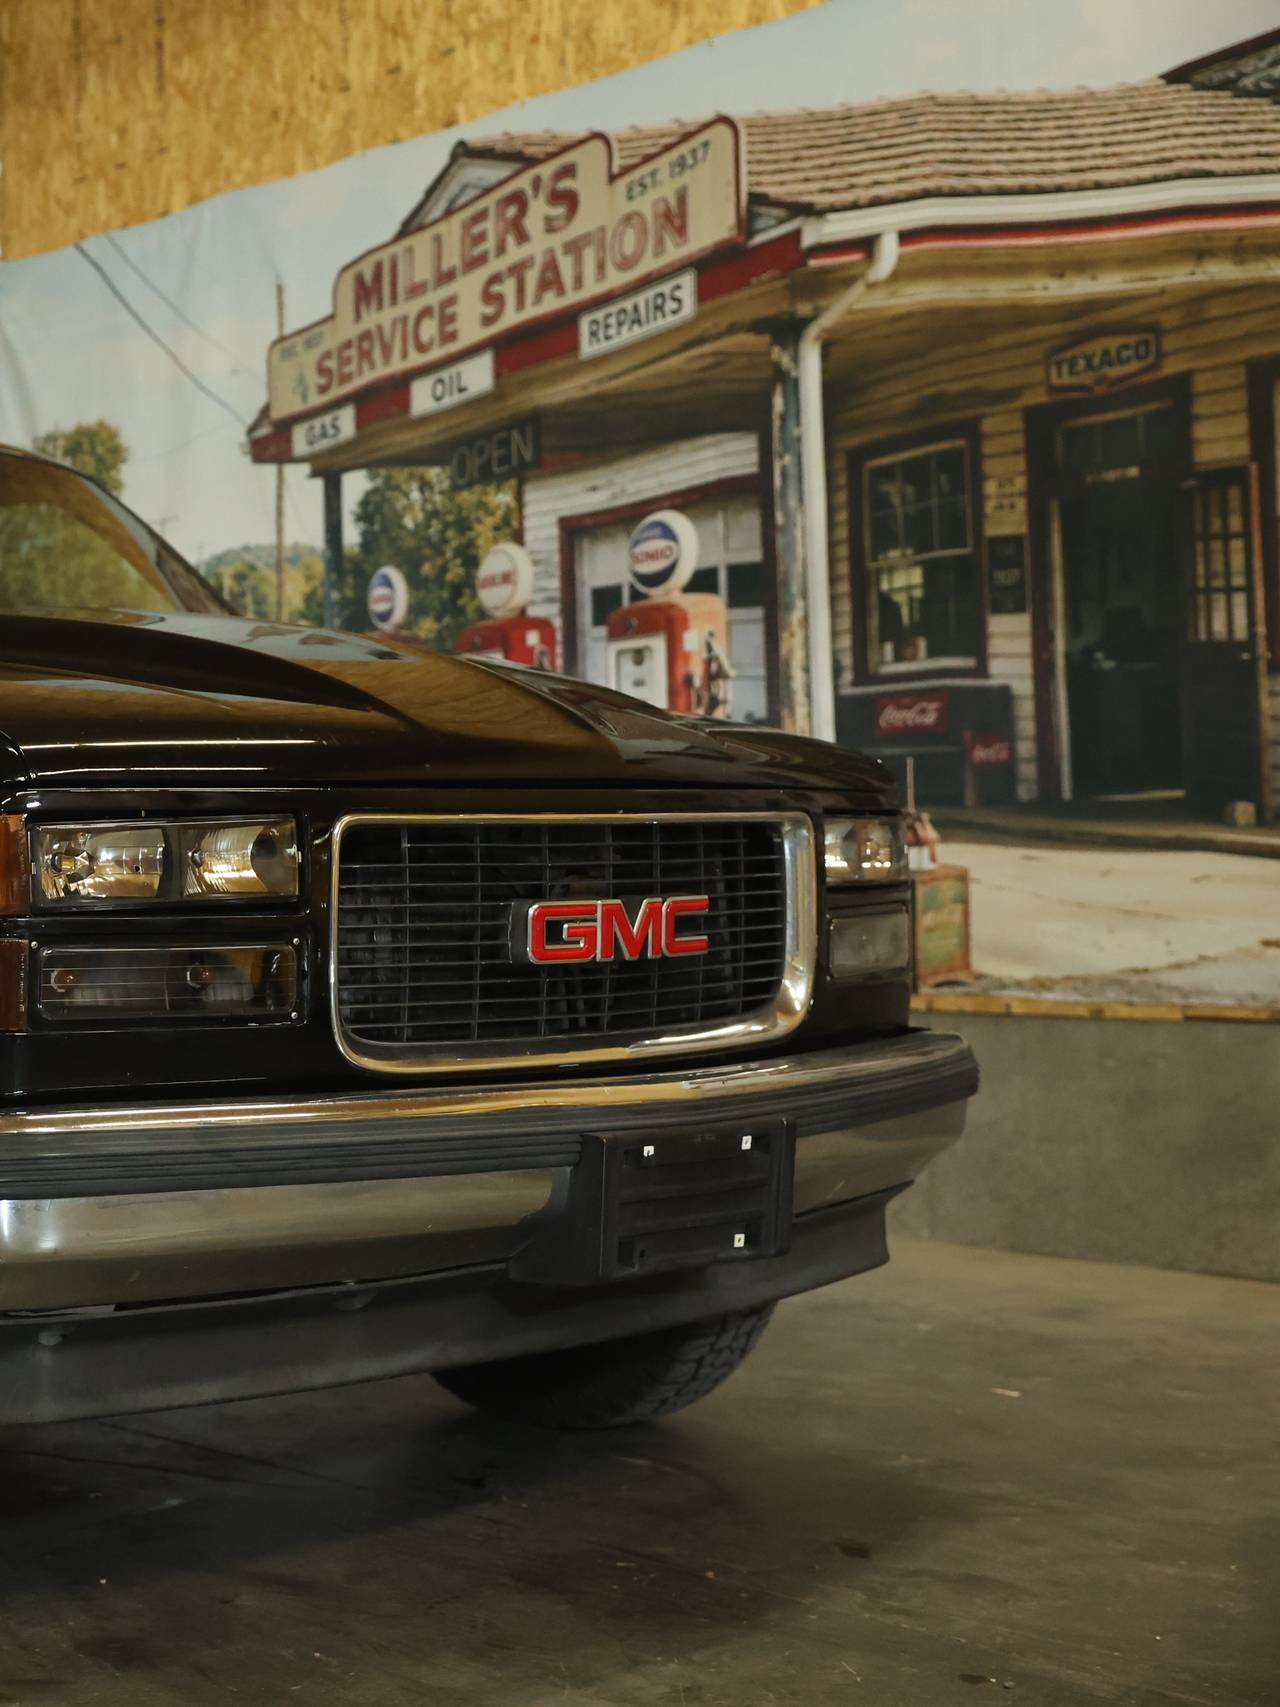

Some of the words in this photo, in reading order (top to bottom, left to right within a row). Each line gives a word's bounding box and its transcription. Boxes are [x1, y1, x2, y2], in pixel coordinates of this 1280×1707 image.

[625, 168, 664, 201] EST.
[669, 139, 711, 180] 1937
[354, 160, 579, 324] MILLER'S
[316, 293, 460, 396] SERVICE
[480, 184, 688, 328] STATION
[588, 283, 683, 346] REPAIRS
[431, 370, 468, 402] OIL
[1053, 339, 1151, 379] TEXACO
[304, 415, 341, 447] GAS
[451, 425, 534, 485] OPEN
[527, 895, 710, 965] GMC
